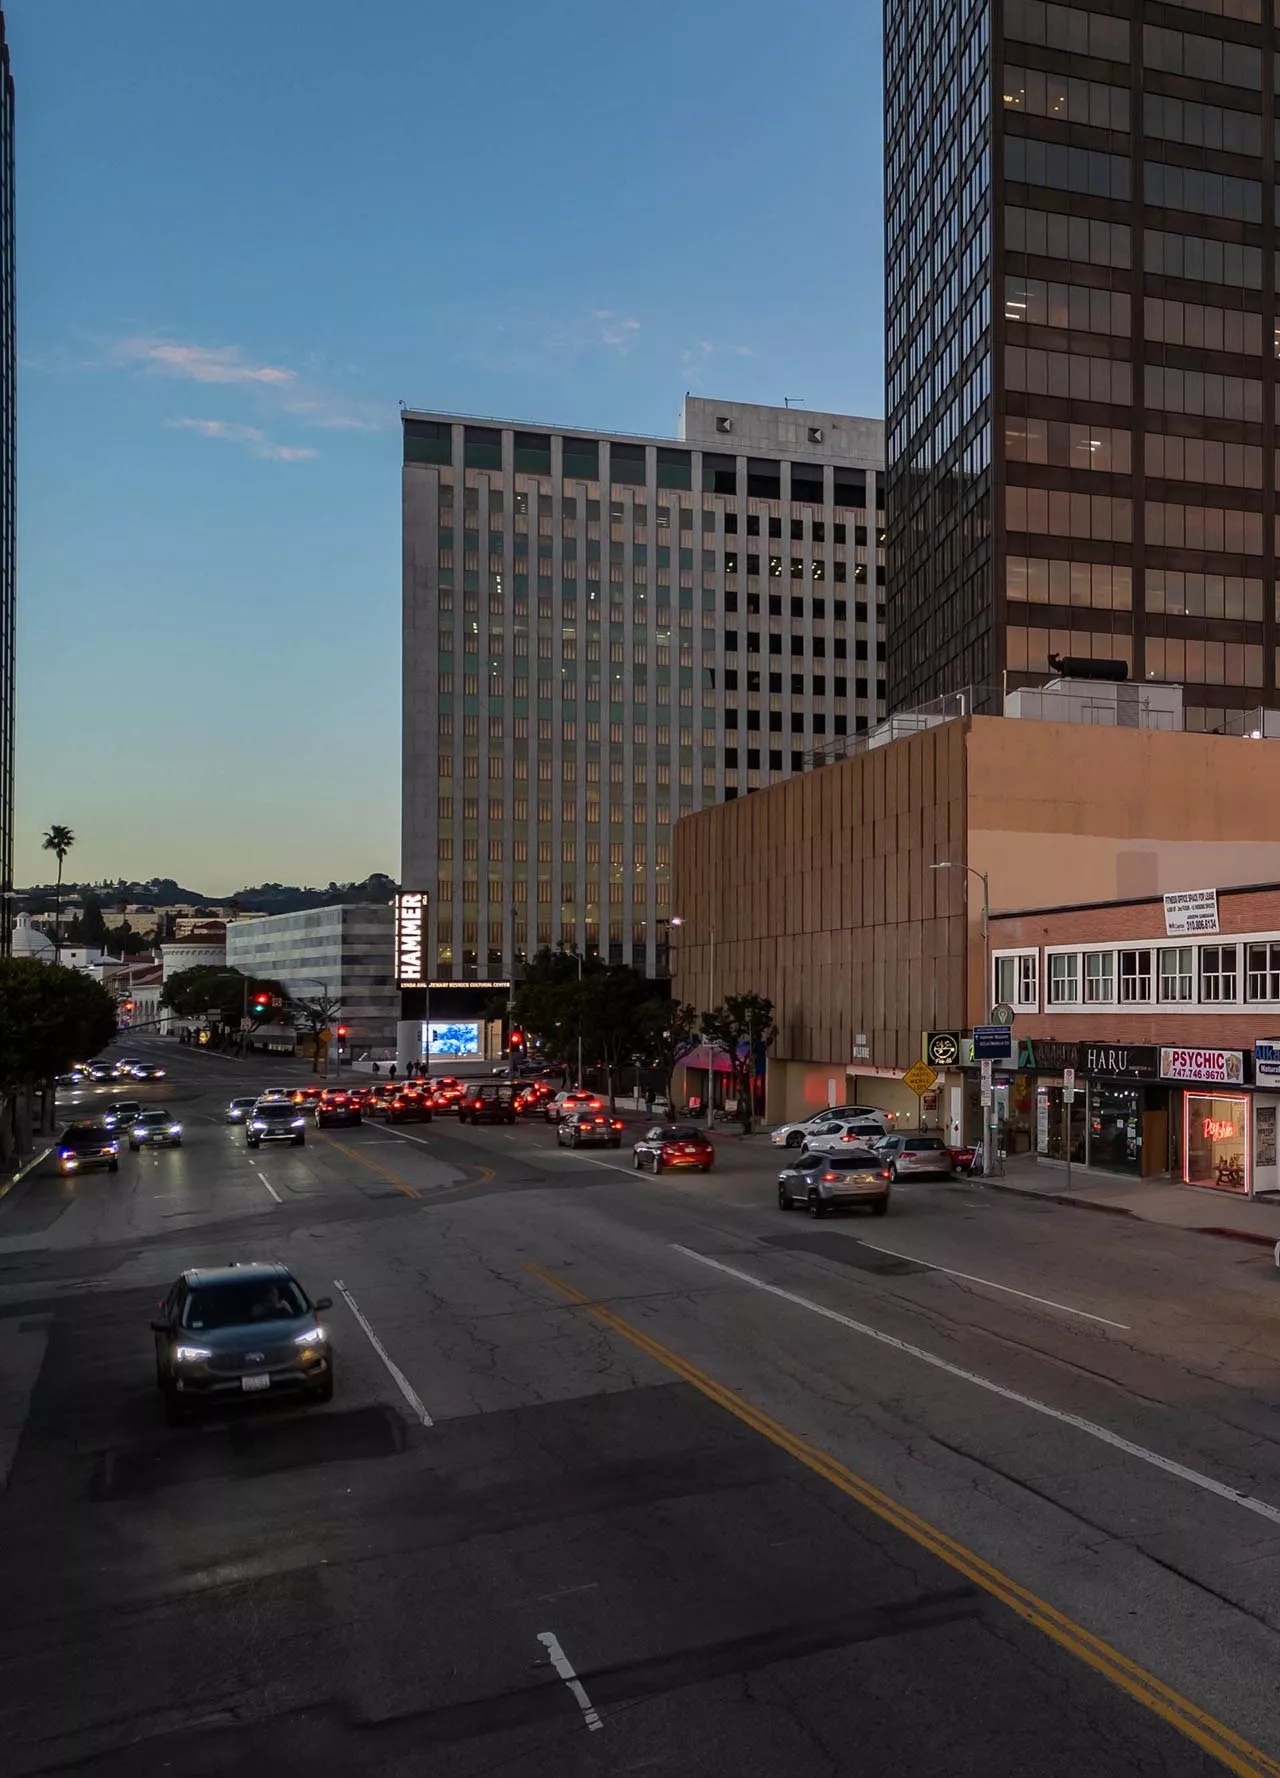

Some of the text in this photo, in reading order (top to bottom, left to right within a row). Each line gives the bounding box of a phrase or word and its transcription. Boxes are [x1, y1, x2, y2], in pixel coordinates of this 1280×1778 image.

[400, 894, 422, 979] HAMMER
[1087, 1048, 1128, 1071] HARU
[1172, 1051, 1225, 1070] PSYCHIC
[1255, 1046, 1280, 1060] Alka
[1260, 1064, 1280, 1074] Natural
